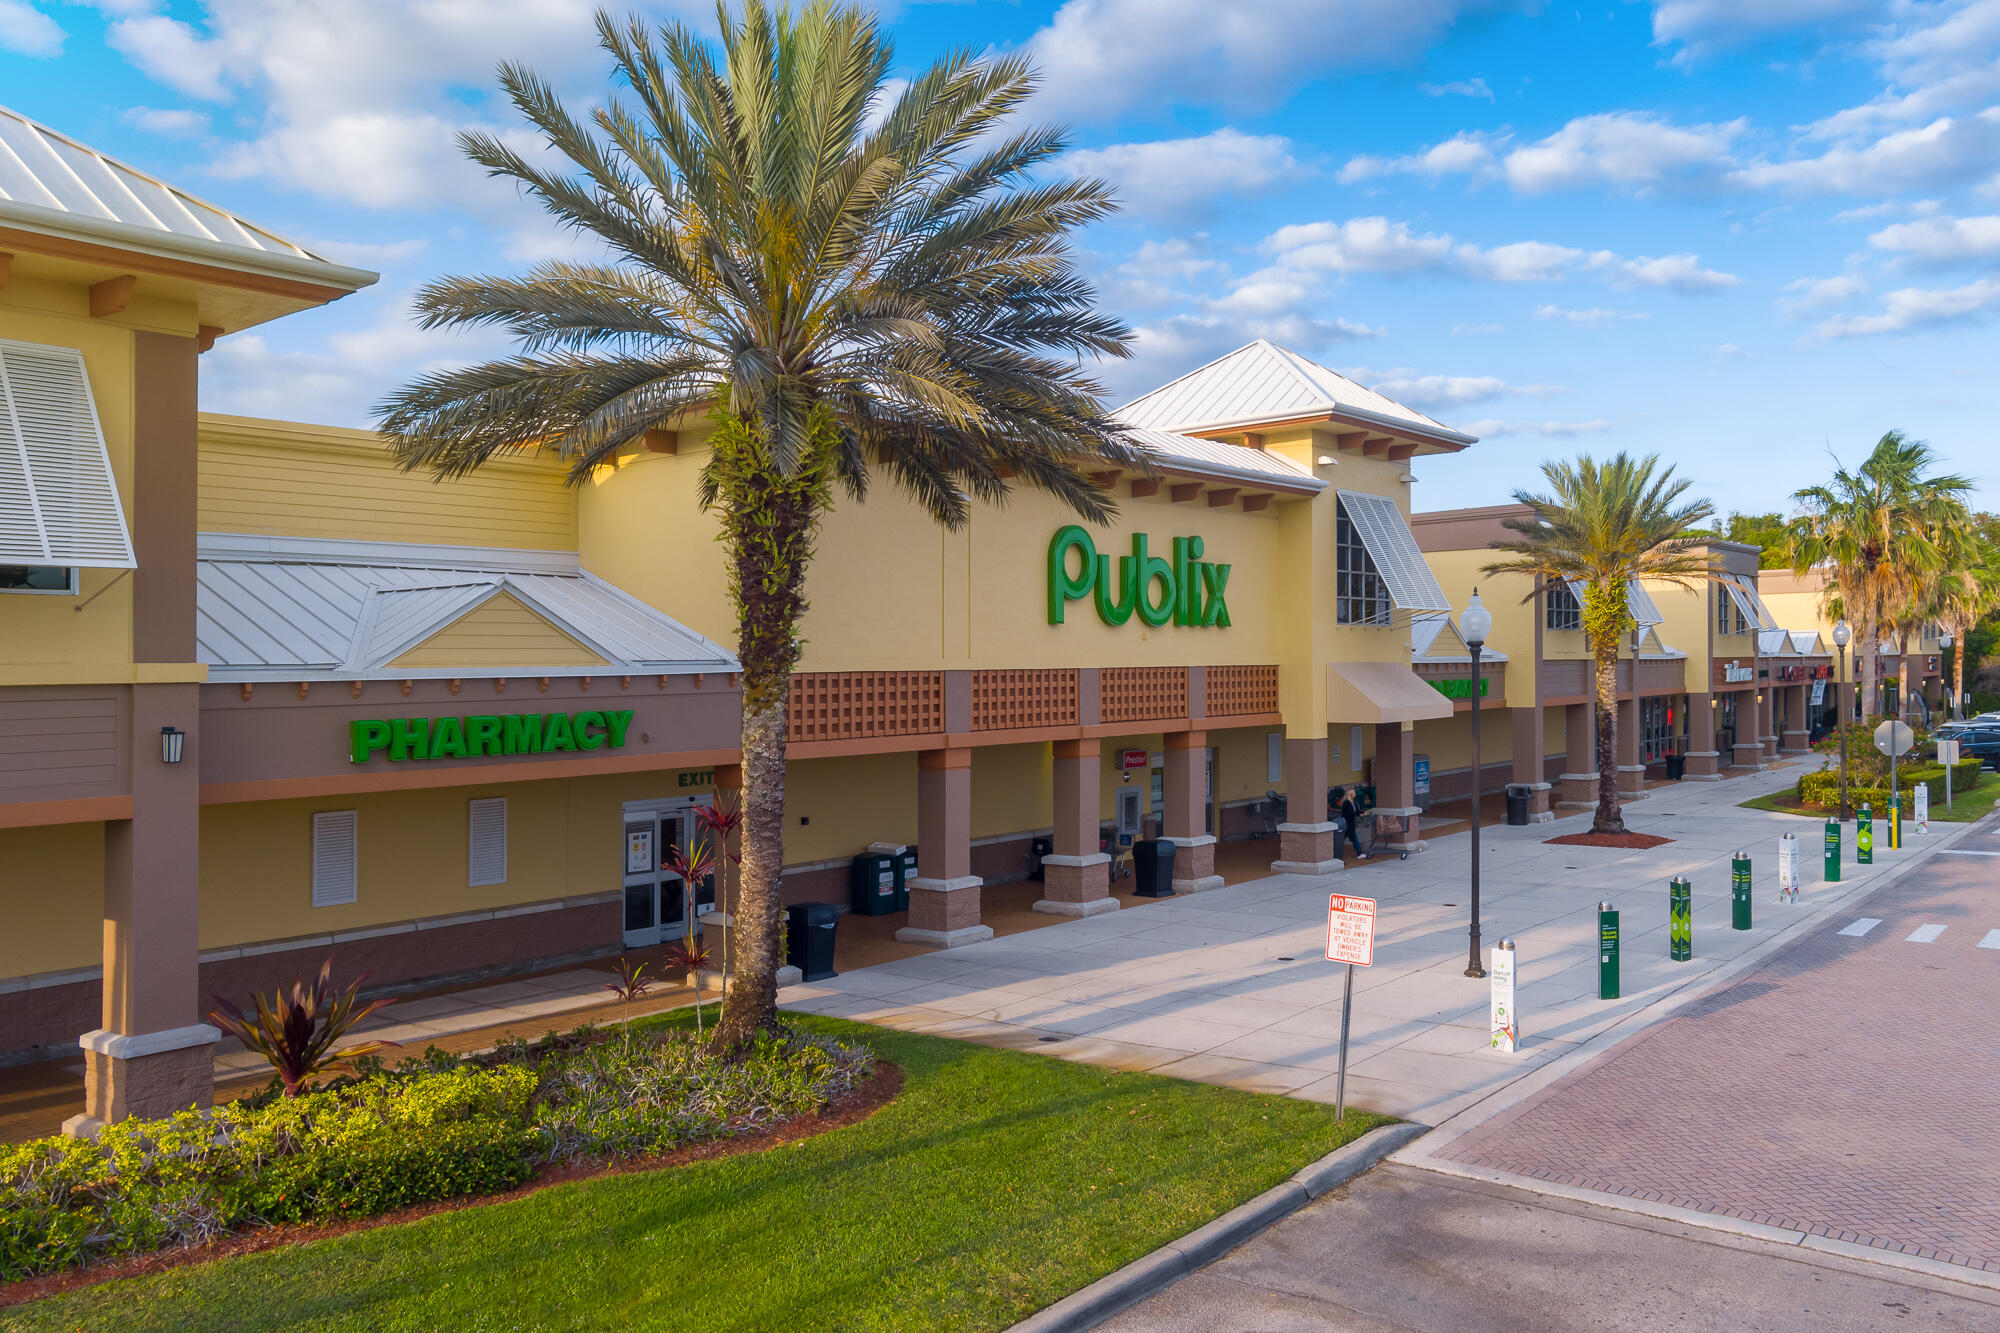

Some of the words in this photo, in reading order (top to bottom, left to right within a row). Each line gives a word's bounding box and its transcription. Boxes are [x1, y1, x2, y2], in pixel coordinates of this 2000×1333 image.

[1048, 525, 1232, 627] Publix
[350, 710, 634, 763] PHARMACY
[1125, 755, 1146, 765] Presto!
[678, 771, 715, 787] EXIT
[1332, 897, 1344, 909] NO
[1345, 901, 1373, 912] PARKING
[1337, 914, 1367, 923] VIOLATORS
[1333, 927, 1352, 935] TOWED
[1353, 930, 1368, 939] AWAY
[1343, 937, 1366, 946] VEHICLE
[1337, 951, 1361, 960] EXPENSE
